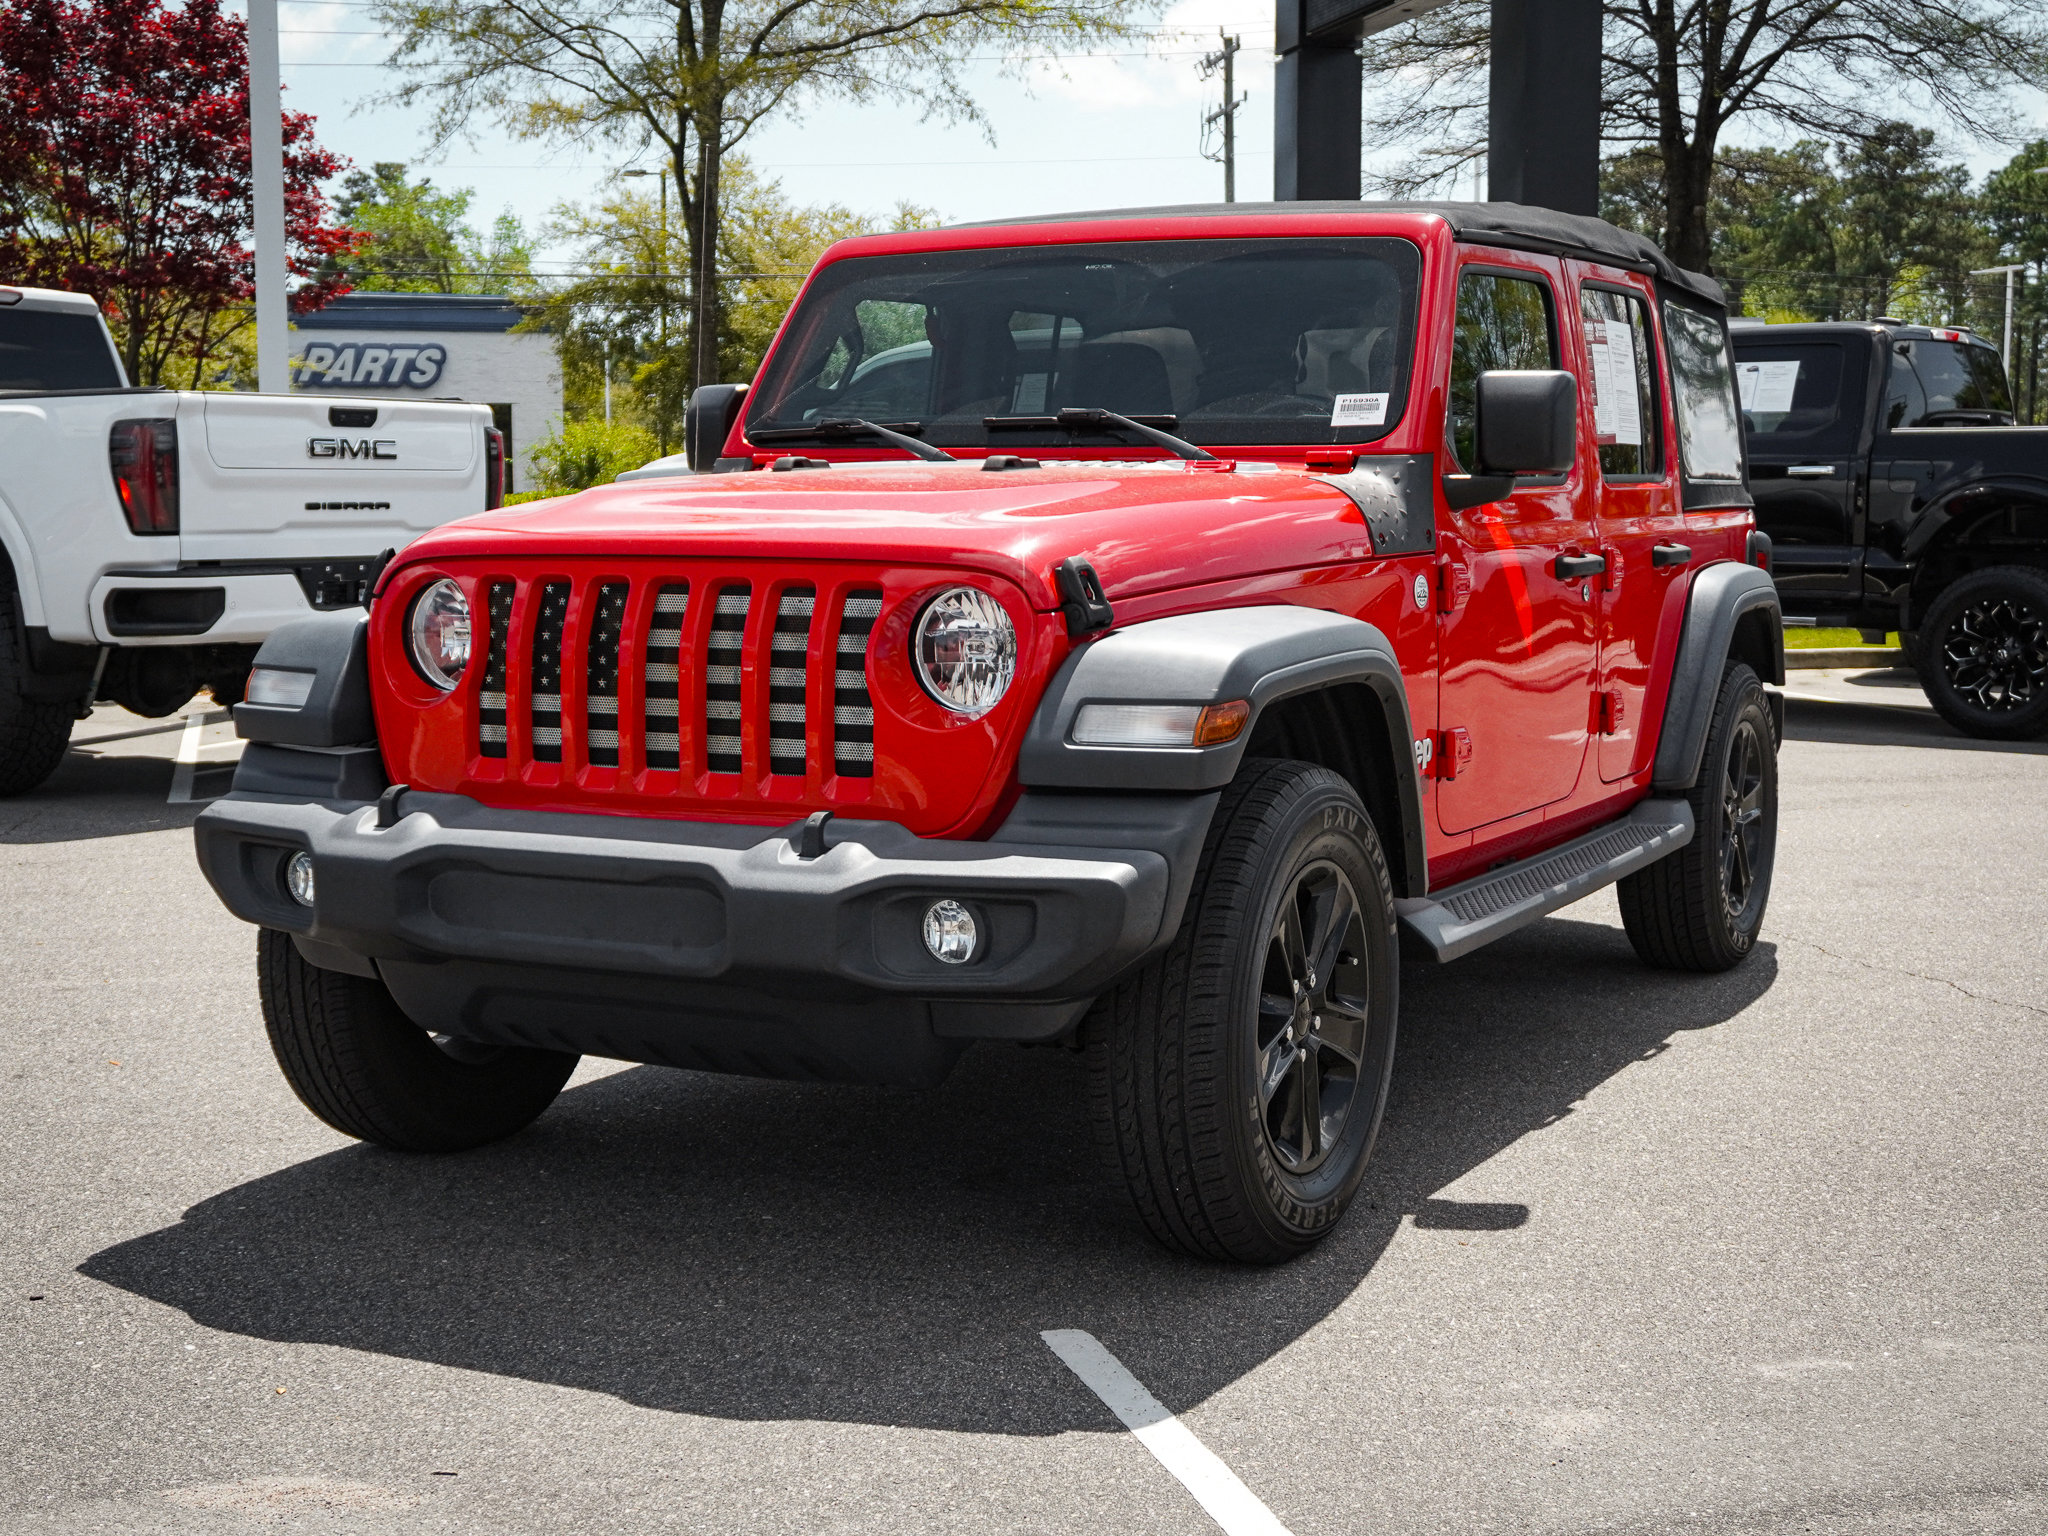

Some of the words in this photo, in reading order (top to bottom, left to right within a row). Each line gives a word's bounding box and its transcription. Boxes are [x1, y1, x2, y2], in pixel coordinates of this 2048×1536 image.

[297, 346, 443, 384] PARTS
[306, 438, 397, 459] GMC
[304, 502, 390, 510] SIERRA
[1414, 737, 1433, 770] ep
[1323, 806, 1359, 832] CXV
